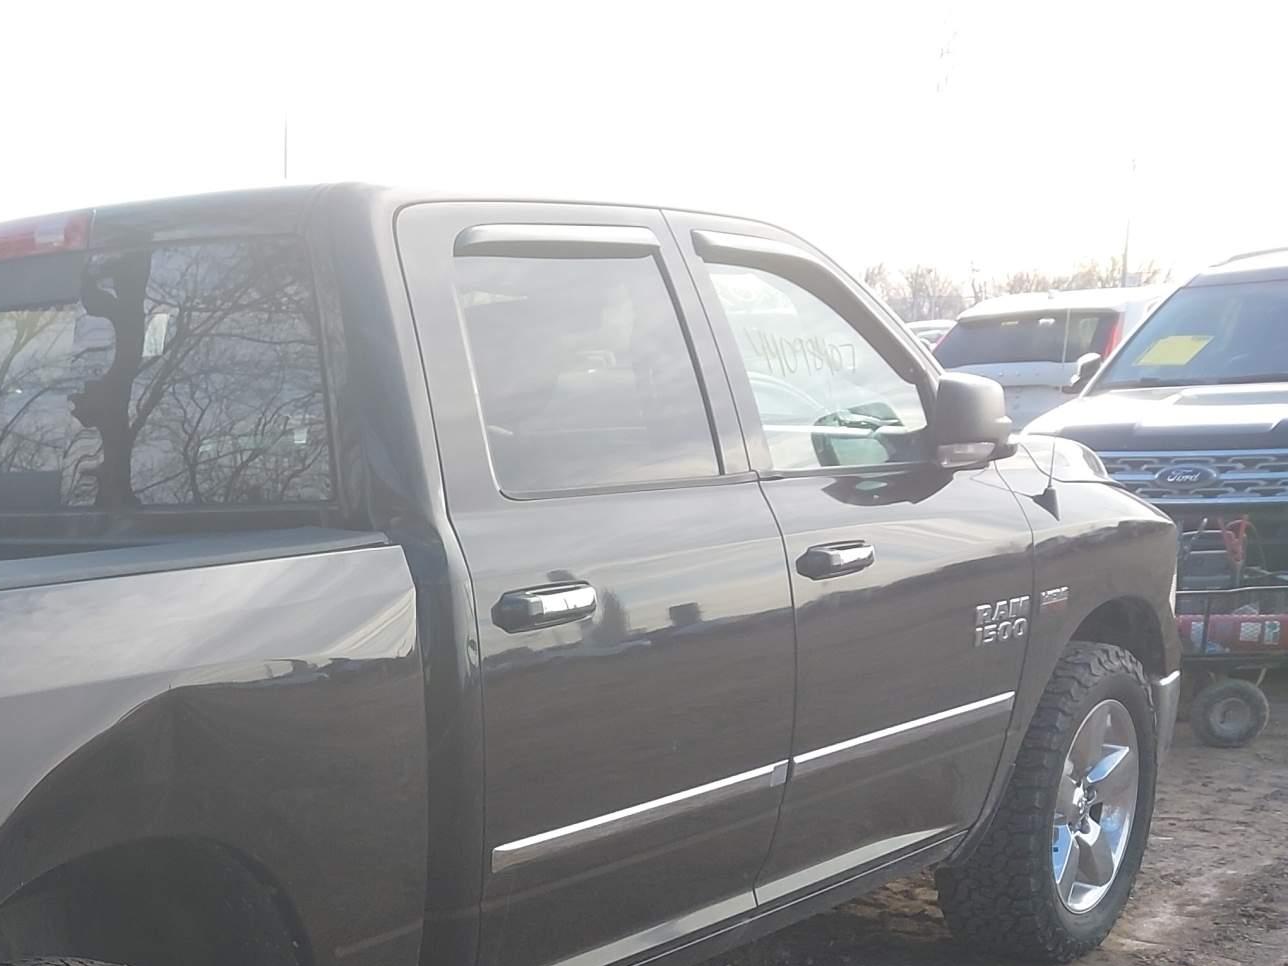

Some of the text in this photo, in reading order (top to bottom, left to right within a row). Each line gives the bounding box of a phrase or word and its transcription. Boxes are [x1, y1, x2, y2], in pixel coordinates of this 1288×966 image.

[743, 327, 856, 377] 44098407
[1167, 470, 1201, 482] Ford
[975, 596, 1031, 624] RAM
[975, 617, 1029, 647] 1500
